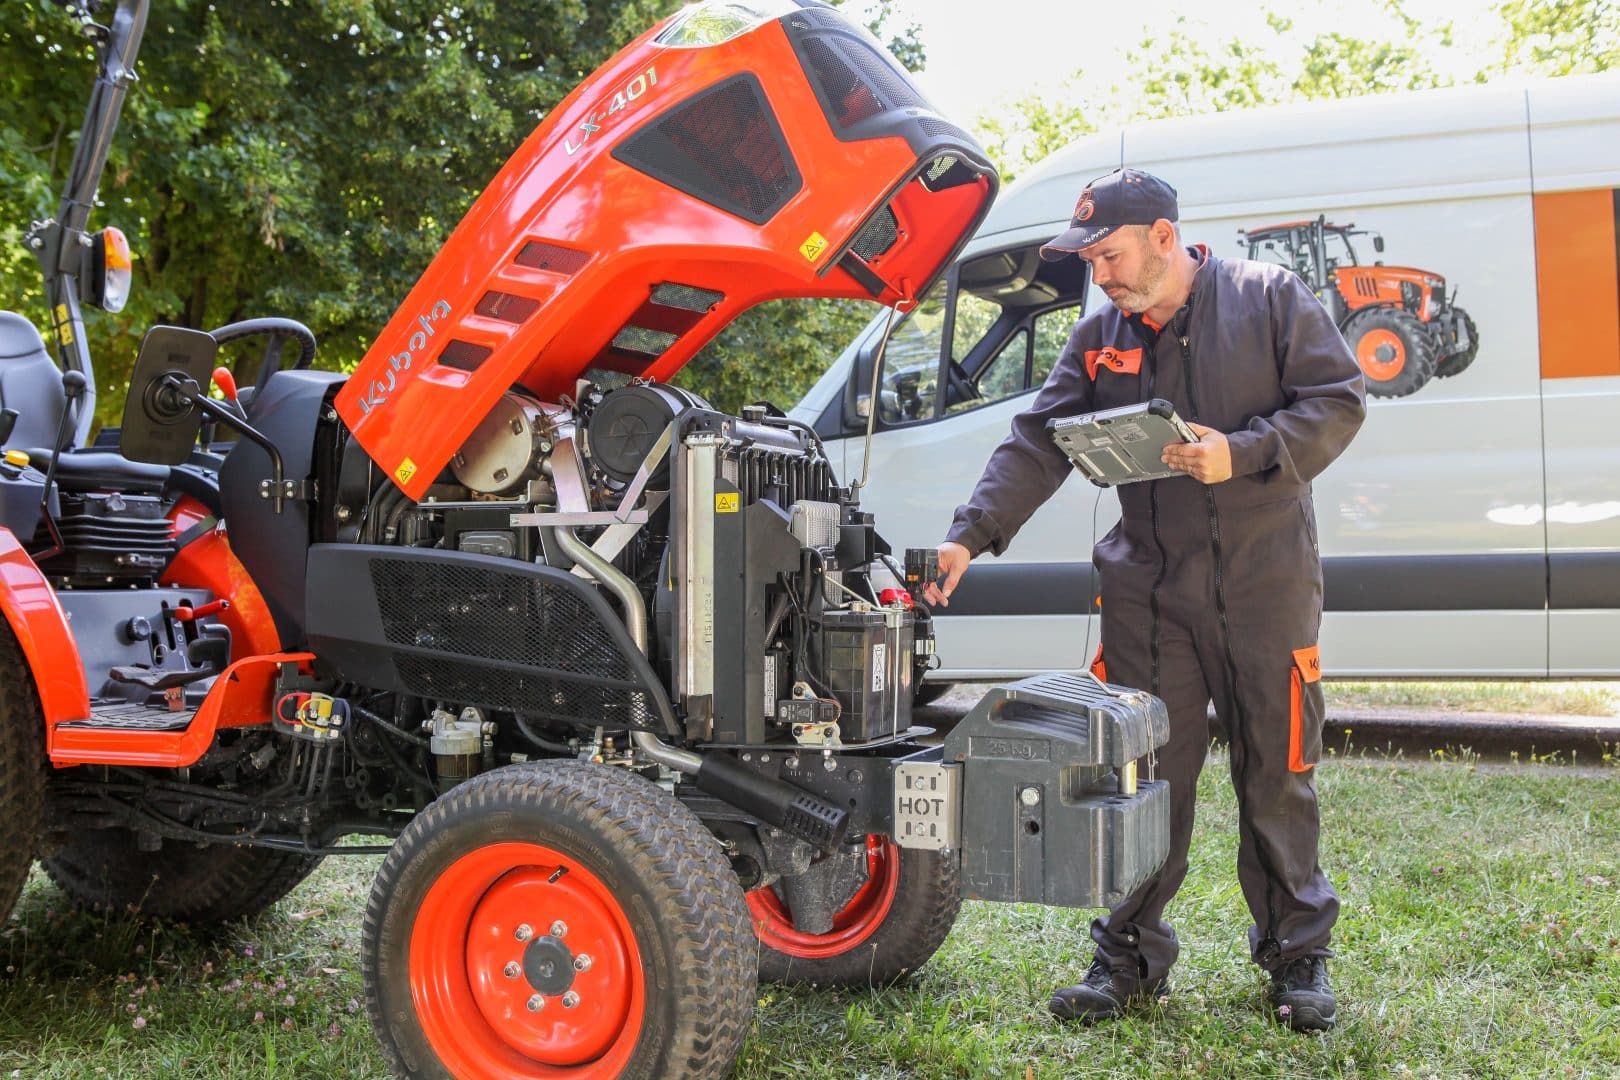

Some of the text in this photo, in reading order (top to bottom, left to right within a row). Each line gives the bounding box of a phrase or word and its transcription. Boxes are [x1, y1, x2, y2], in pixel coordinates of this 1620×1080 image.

[564, 66, 657, 155] LX-401
[358, 300, 452, 415] Kubota
[898, 797, 945, 817] HOT
